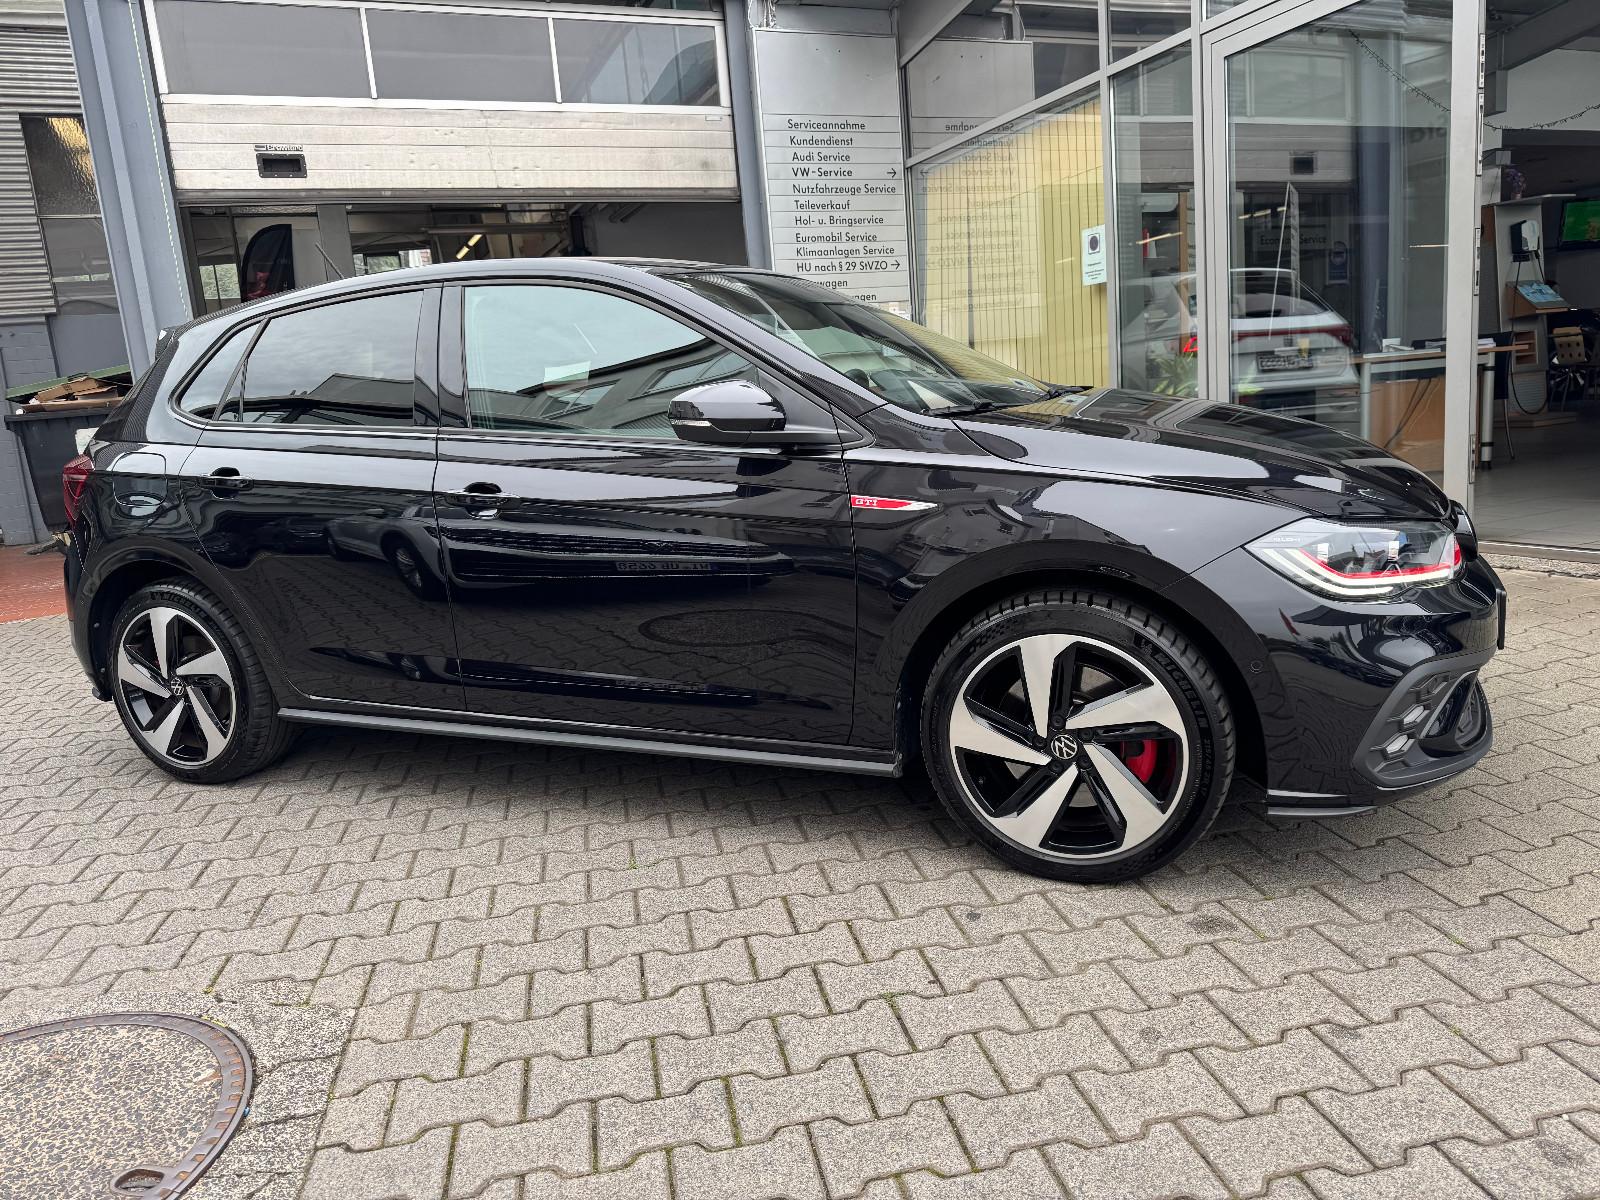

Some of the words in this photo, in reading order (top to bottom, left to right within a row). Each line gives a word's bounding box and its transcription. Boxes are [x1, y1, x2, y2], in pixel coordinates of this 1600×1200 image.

[787, 119, 866, 130] Serviceannahme
[789, 135, 853, 146] Kundendienst
[792, 152, 815, 162] Audi
[817, 152, 851, 162] Service
[792, 183, 862, 195] Nutzfahrzeuge
[864, 184, 896, 194] Service
[794, 200, 851, 210] Teileverkauf
[795, 215, 816, 226] Hol-
[829, 215, 884, 227] Bringservice
[795, 232, 843, 243] Euromobil
[845, 232, 878, 242] Service
[796, 246, 861, 258] Klimaanlagen
[863, 246, 895, 255] Service
[797, 262, 812, 272] HU
[815, 262, 837, 272] nach
[846, 261, 857, 271] 29
[860, 260, 888, 271] StVZO
[855, 498, 878, 506] GTI
